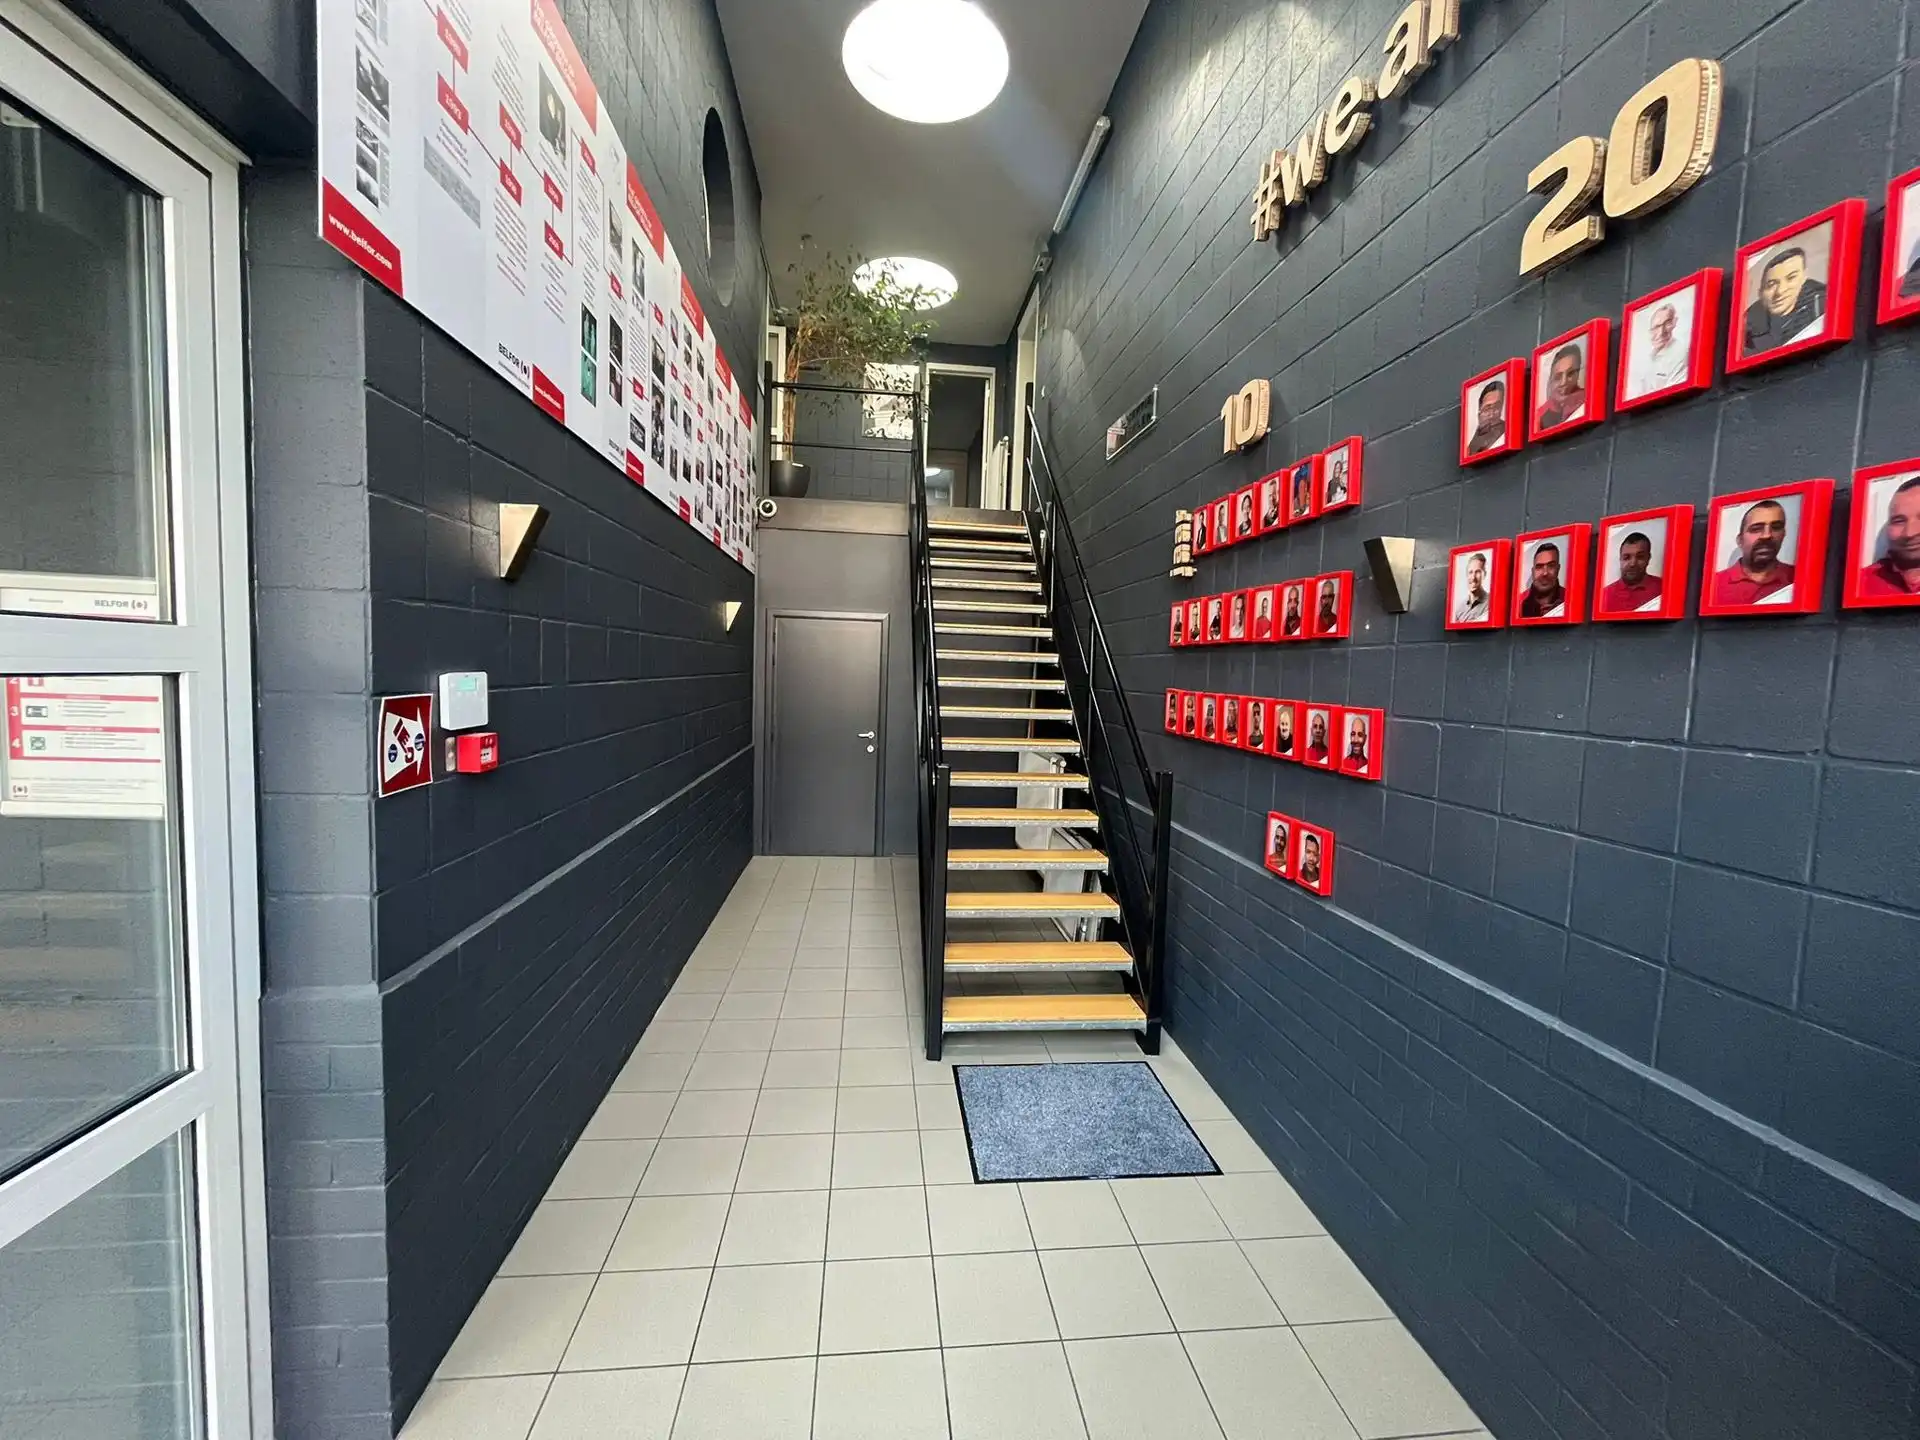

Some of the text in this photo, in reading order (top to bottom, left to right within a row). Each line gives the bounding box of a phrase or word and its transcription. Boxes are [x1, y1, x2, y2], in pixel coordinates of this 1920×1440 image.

[1519, 57, 1723, 277] 20
[328, 212, 393, 271] www.belfor.com
[498, 341, 521, 369] BELFOR
[1220, 378, 1270, 454] 10
[94, 599, 129, 608] BELFOR
[10, 705, 19, 717] 3
[11, 737, 21, 749] 4
